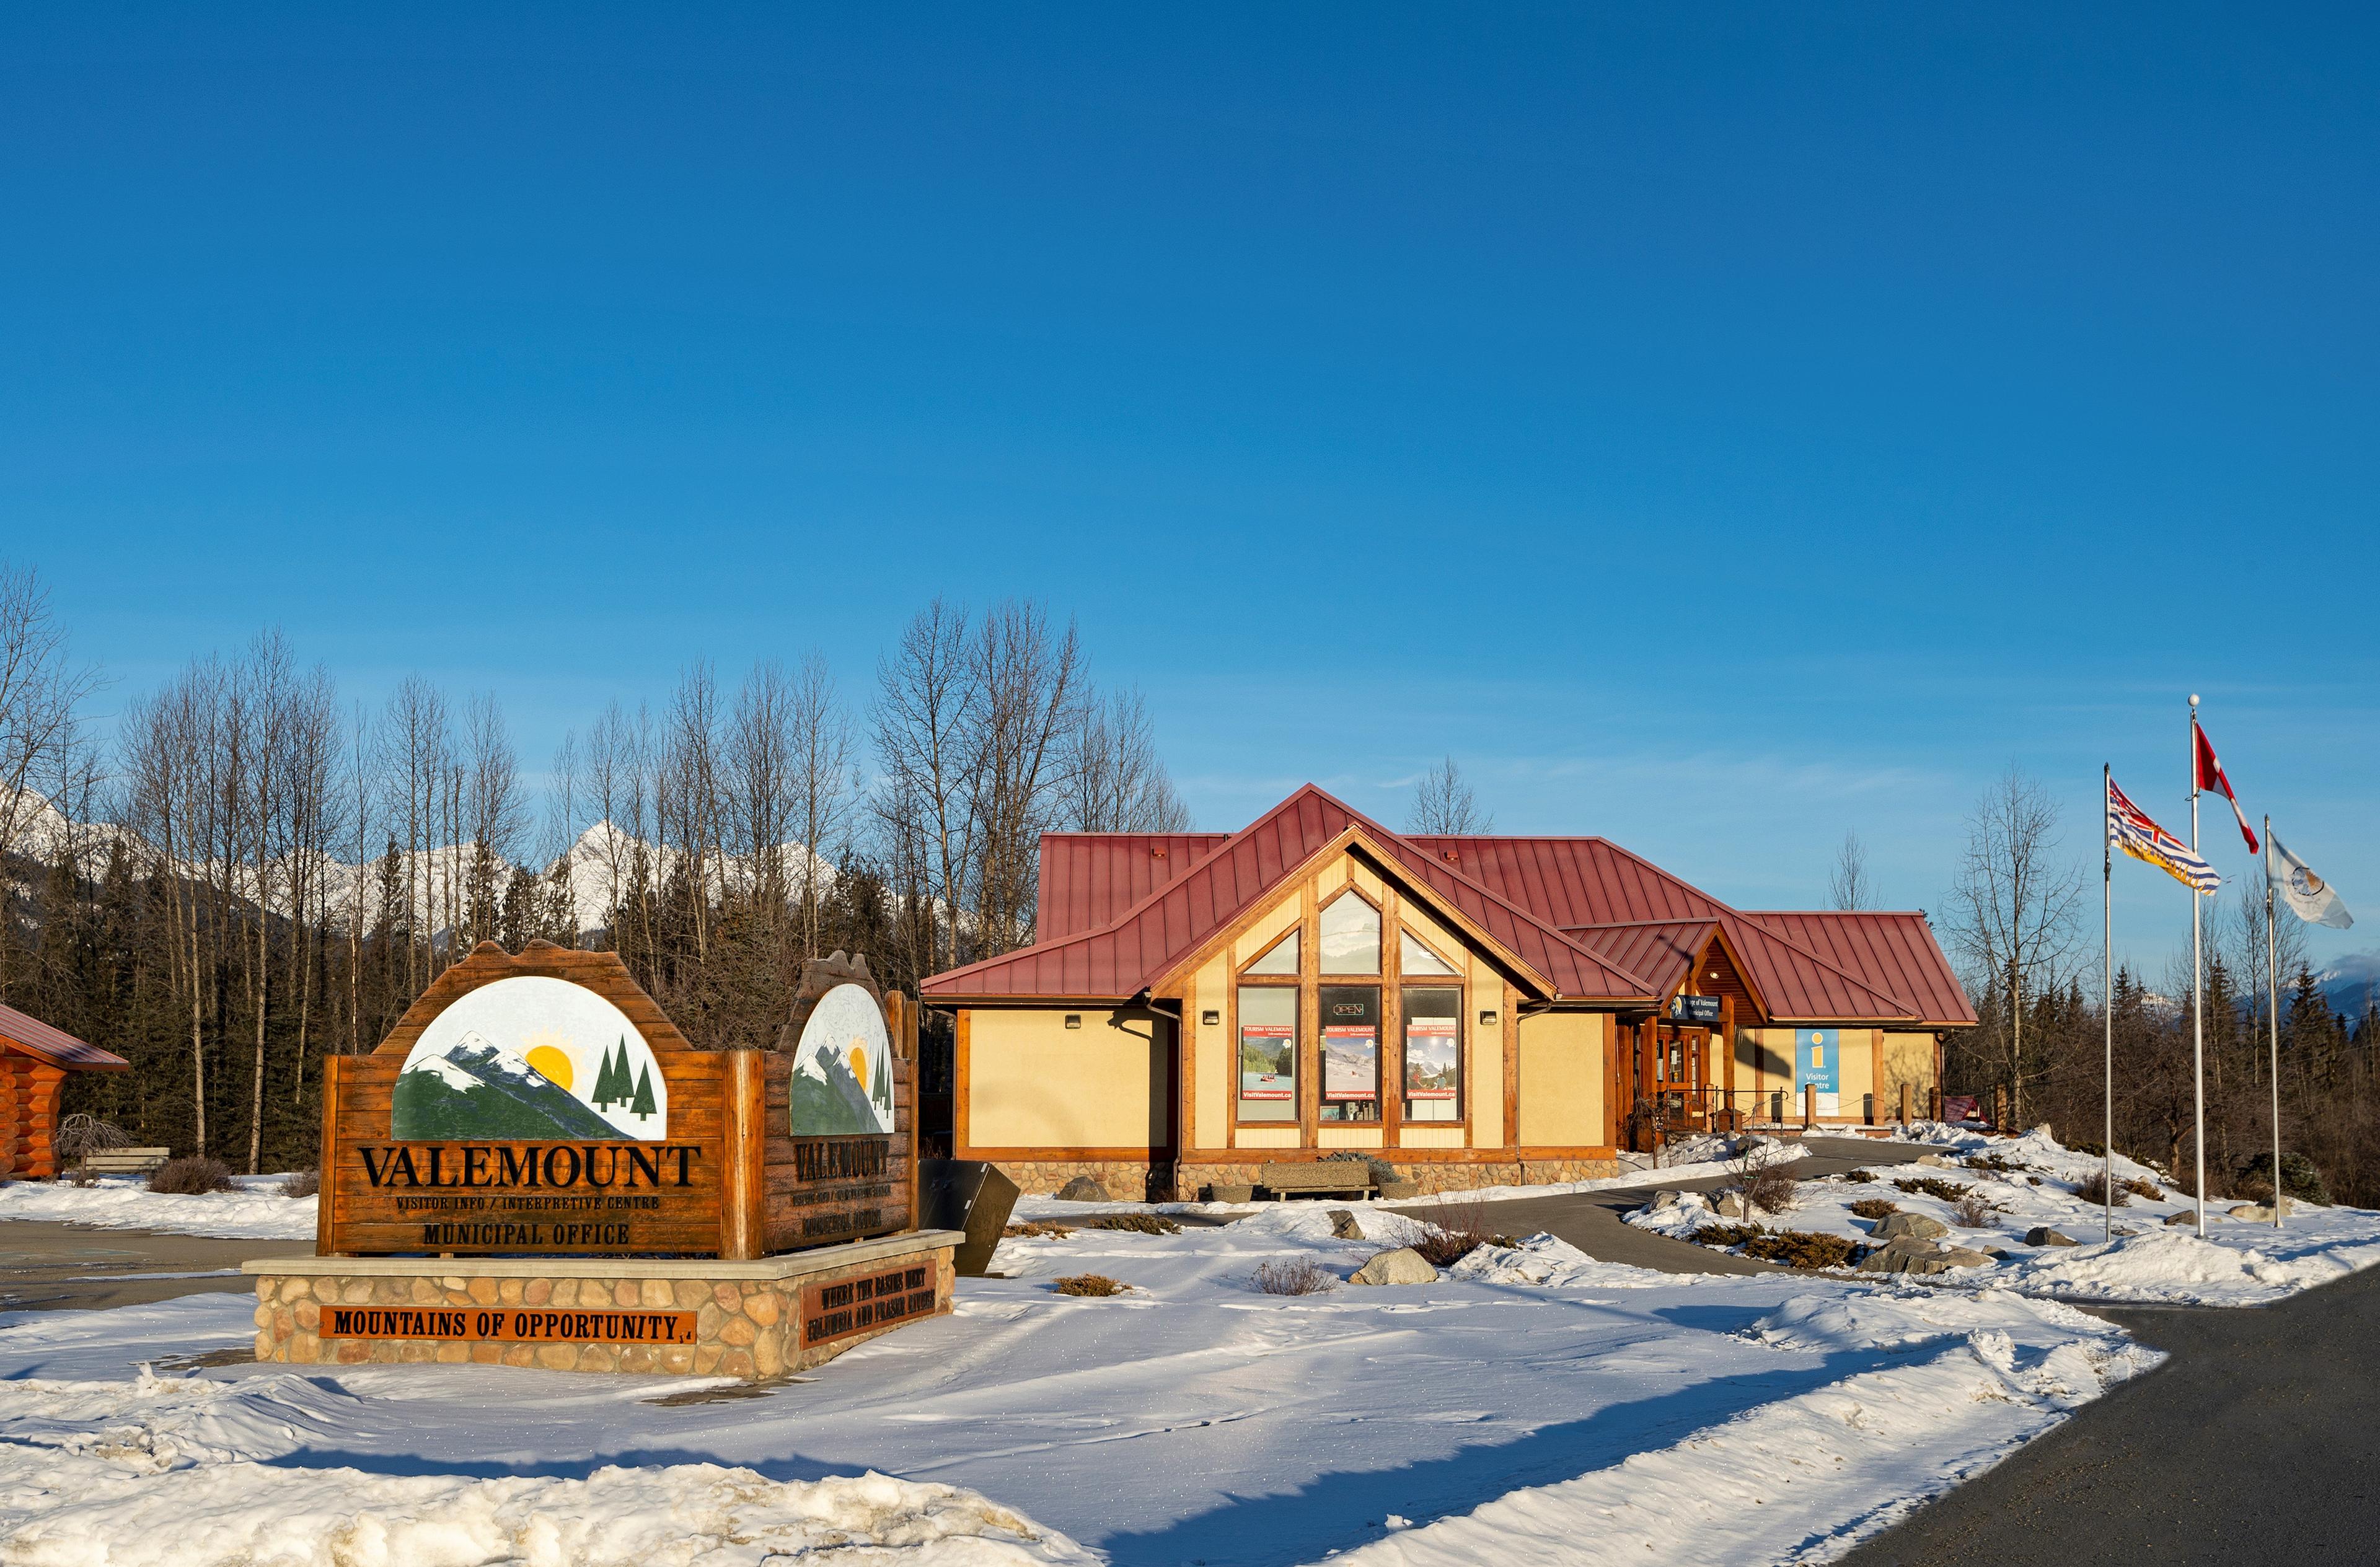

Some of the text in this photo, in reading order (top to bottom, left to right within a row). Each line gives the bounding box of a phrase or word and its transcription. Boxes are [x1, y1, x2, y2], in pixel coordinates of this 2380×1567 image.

[1334, 1006, 1362, 1014] OPEN
[1805, 1073, 1829, 1081] Visitor
[1806, 1081, 1829, 1089] ntre
[357, 1146, 701, 1188] VALEMOUNT
[795, 1139, 889, 1182] VALEMOUNT
[397, 1196, 447, 1209] VISITOR
[454, 1196, 485, 1209] INFO
[503, 1196, 601, 1209] INTERPRETIVE
[607, 1196, 659, 1209] CENTRE
[423, 1223, 629, 1245] MUNICIPAL OFFICE
[821, 1283, 854, 1310] WHERE
[857, 1278, 873, 1302] THE
[905, 1268, 926, 1290] MEET
[333, 1310, 466, 1337] MOUNTAINS
[477, 1312, 505, 1337] OF
[514, 1313, 678, 1340] OPPORTUNITY
[807, 1289, 935, 1343] COLUMBIA AND FRASER RIVERS
